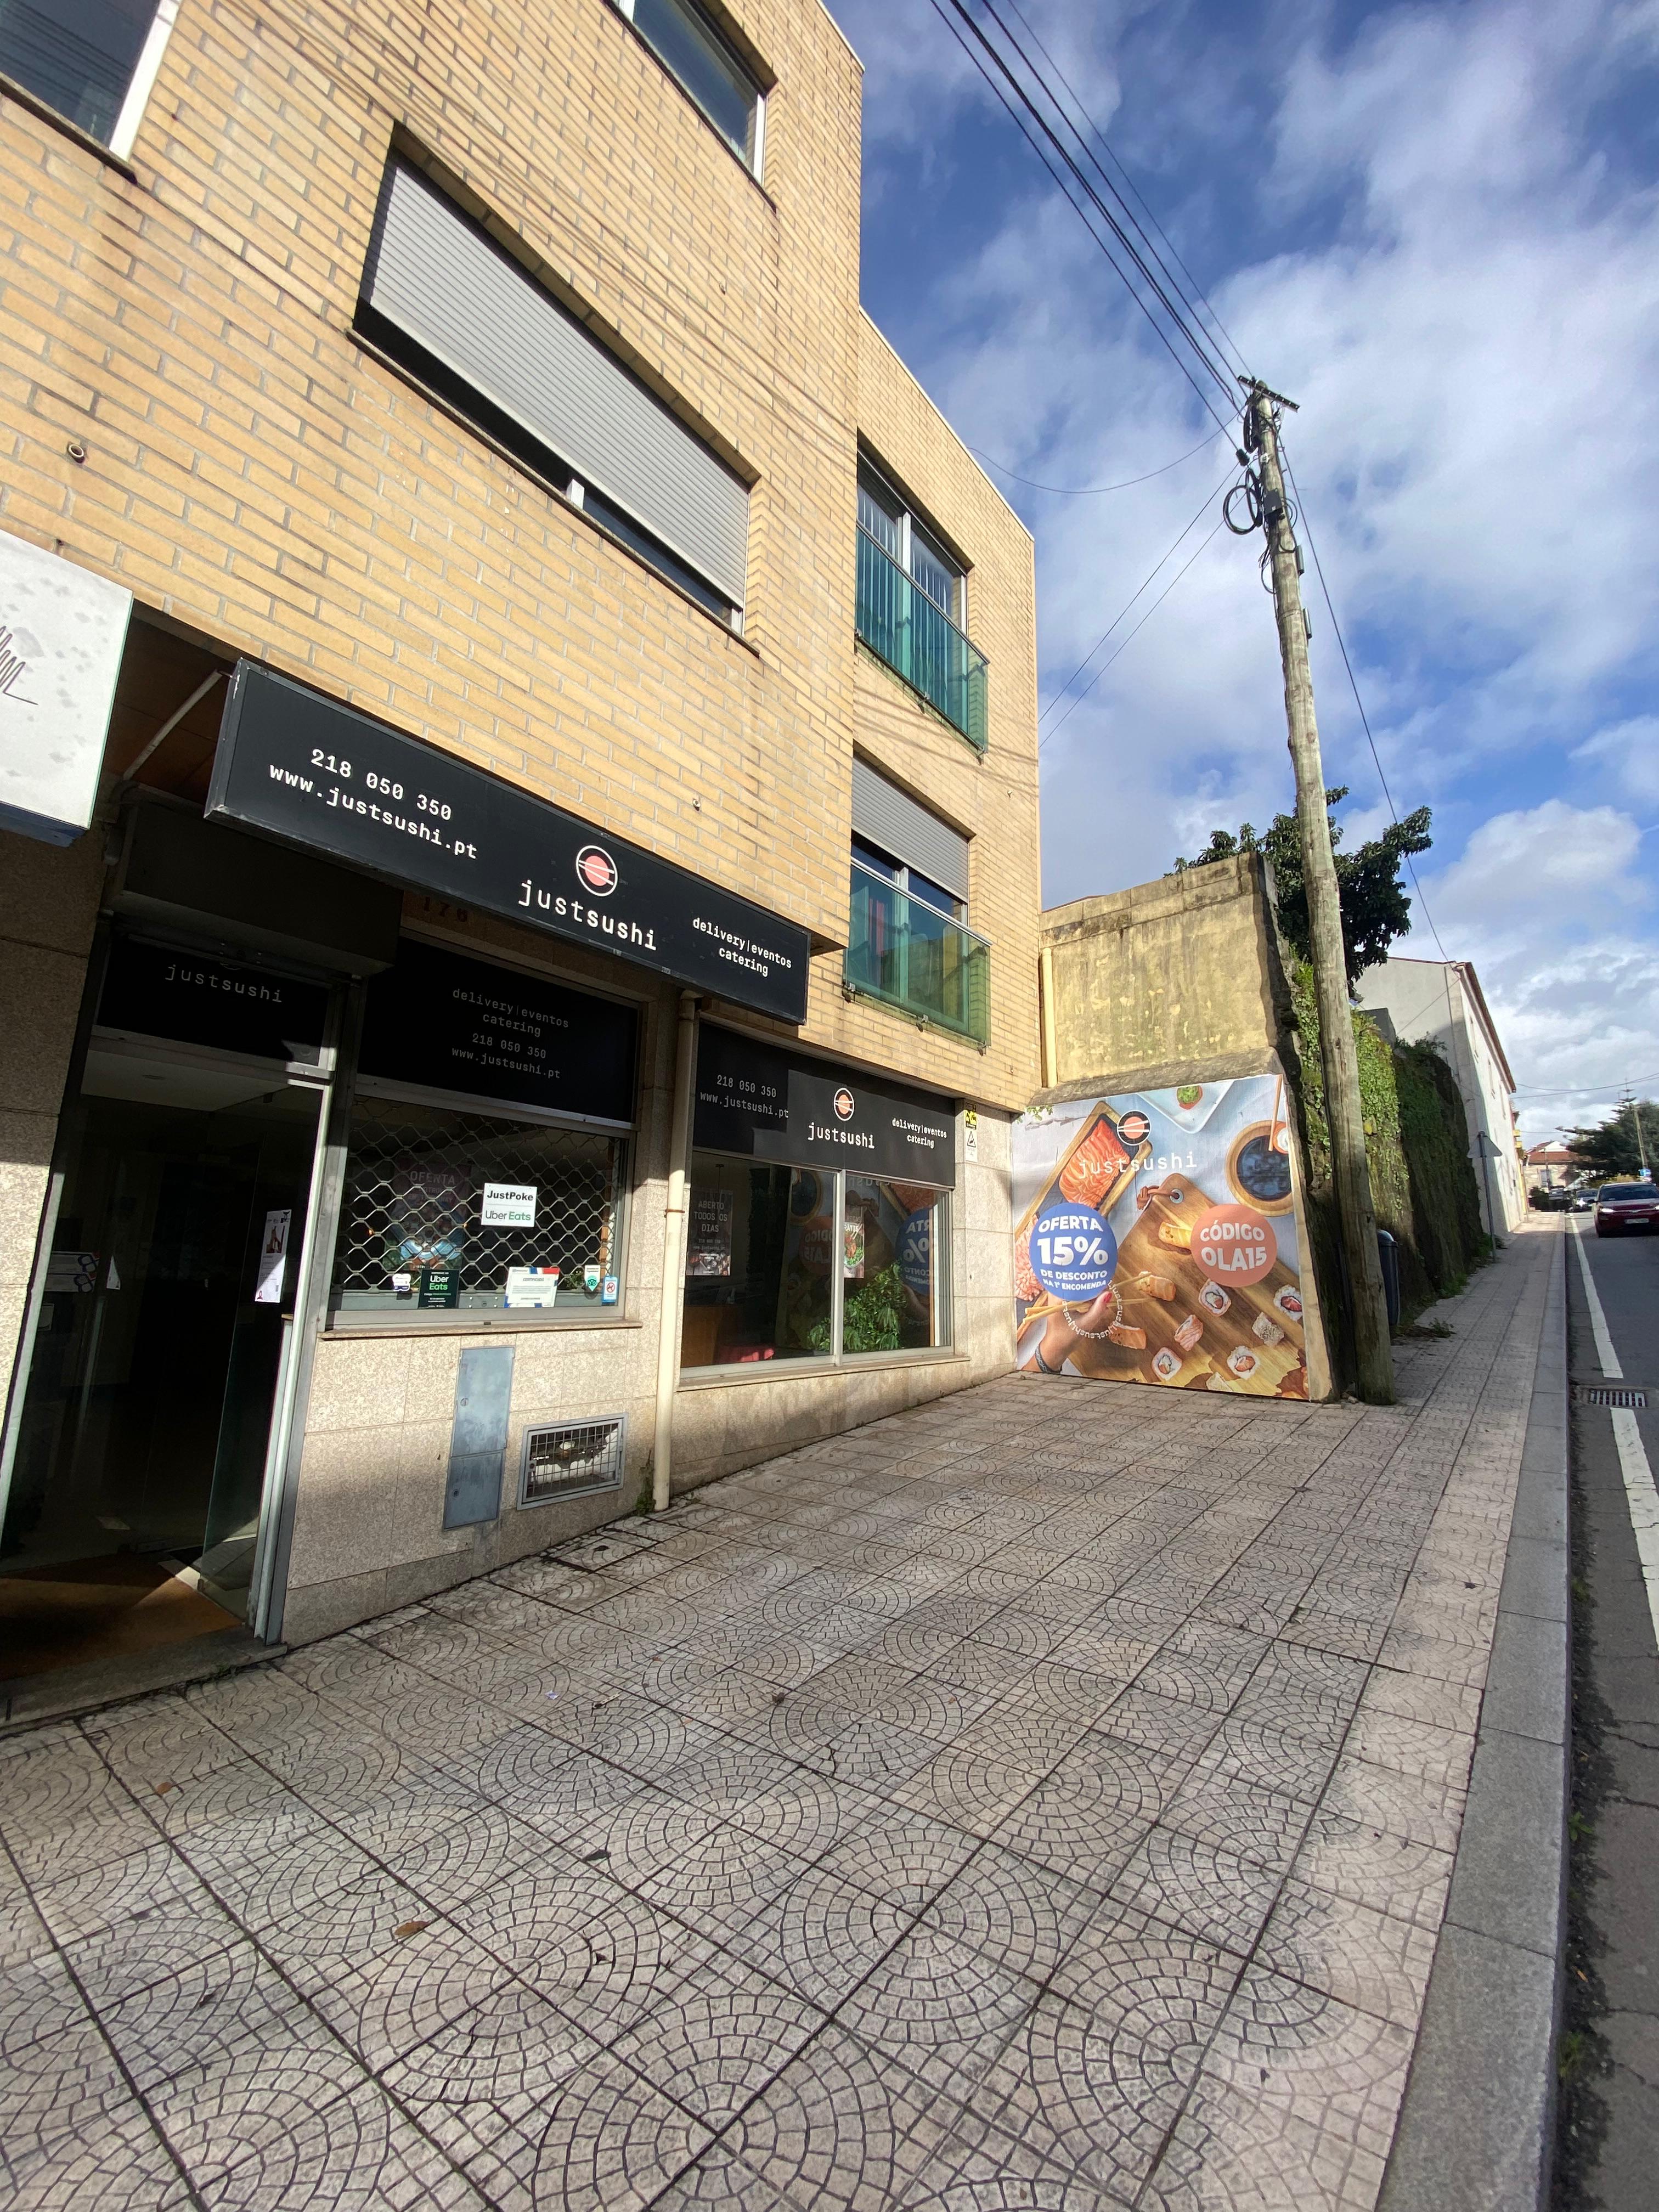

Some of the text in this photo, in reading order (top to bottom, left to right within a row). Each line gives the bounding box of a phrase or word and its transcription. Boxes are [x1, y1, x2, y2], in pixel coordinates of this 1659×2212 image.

[311, 748, 452, 820] 218 050 350
[269, 764, 477, 859] www.justsushi.pt
[518, 880, 656, 951] justsushi
[719, 947, 768, 977] catering
[165, 964, 282, 1003] justsushi
[483, 1013, 541, 1038] catering
[472, 1032, 546, 1059] 218 050 350
[452, 1047, 560, 1079] www.justsushi.pt
[716, 1075, 776, 1098] 218 050 350
[700, 1091, 789, 1119] www.justsushi.pt
[808, 1122, 875, 1149] justsushi
[907, 1135, 934, 1149] catering
[1079, 1152, 1197, 1178] justsushi
[487, 1190, 533, 1201] JustPoke
[698, 1200, 724, 1210] ABERTO
[486, 1210, 531, 1221] Uber Eats
[694, 1211, 728, 1222] TODOS OS
[1039, 1216, 1103, 1233] OFERTA
[701, 1223, 719, 1233] DIAS
[1200, 1220, 1265, 1242] CÓDIGO
[1037, 1236, 1108, 1266] 15%
[1201, 1247, 1267, 1271] OLA15
[1040, 1269, 1107, 1281] DE DESCONTO
[1043, 1278, 1054, 1287] NA
[1062, 1280, 1106, 1290] ENCOMENDA
